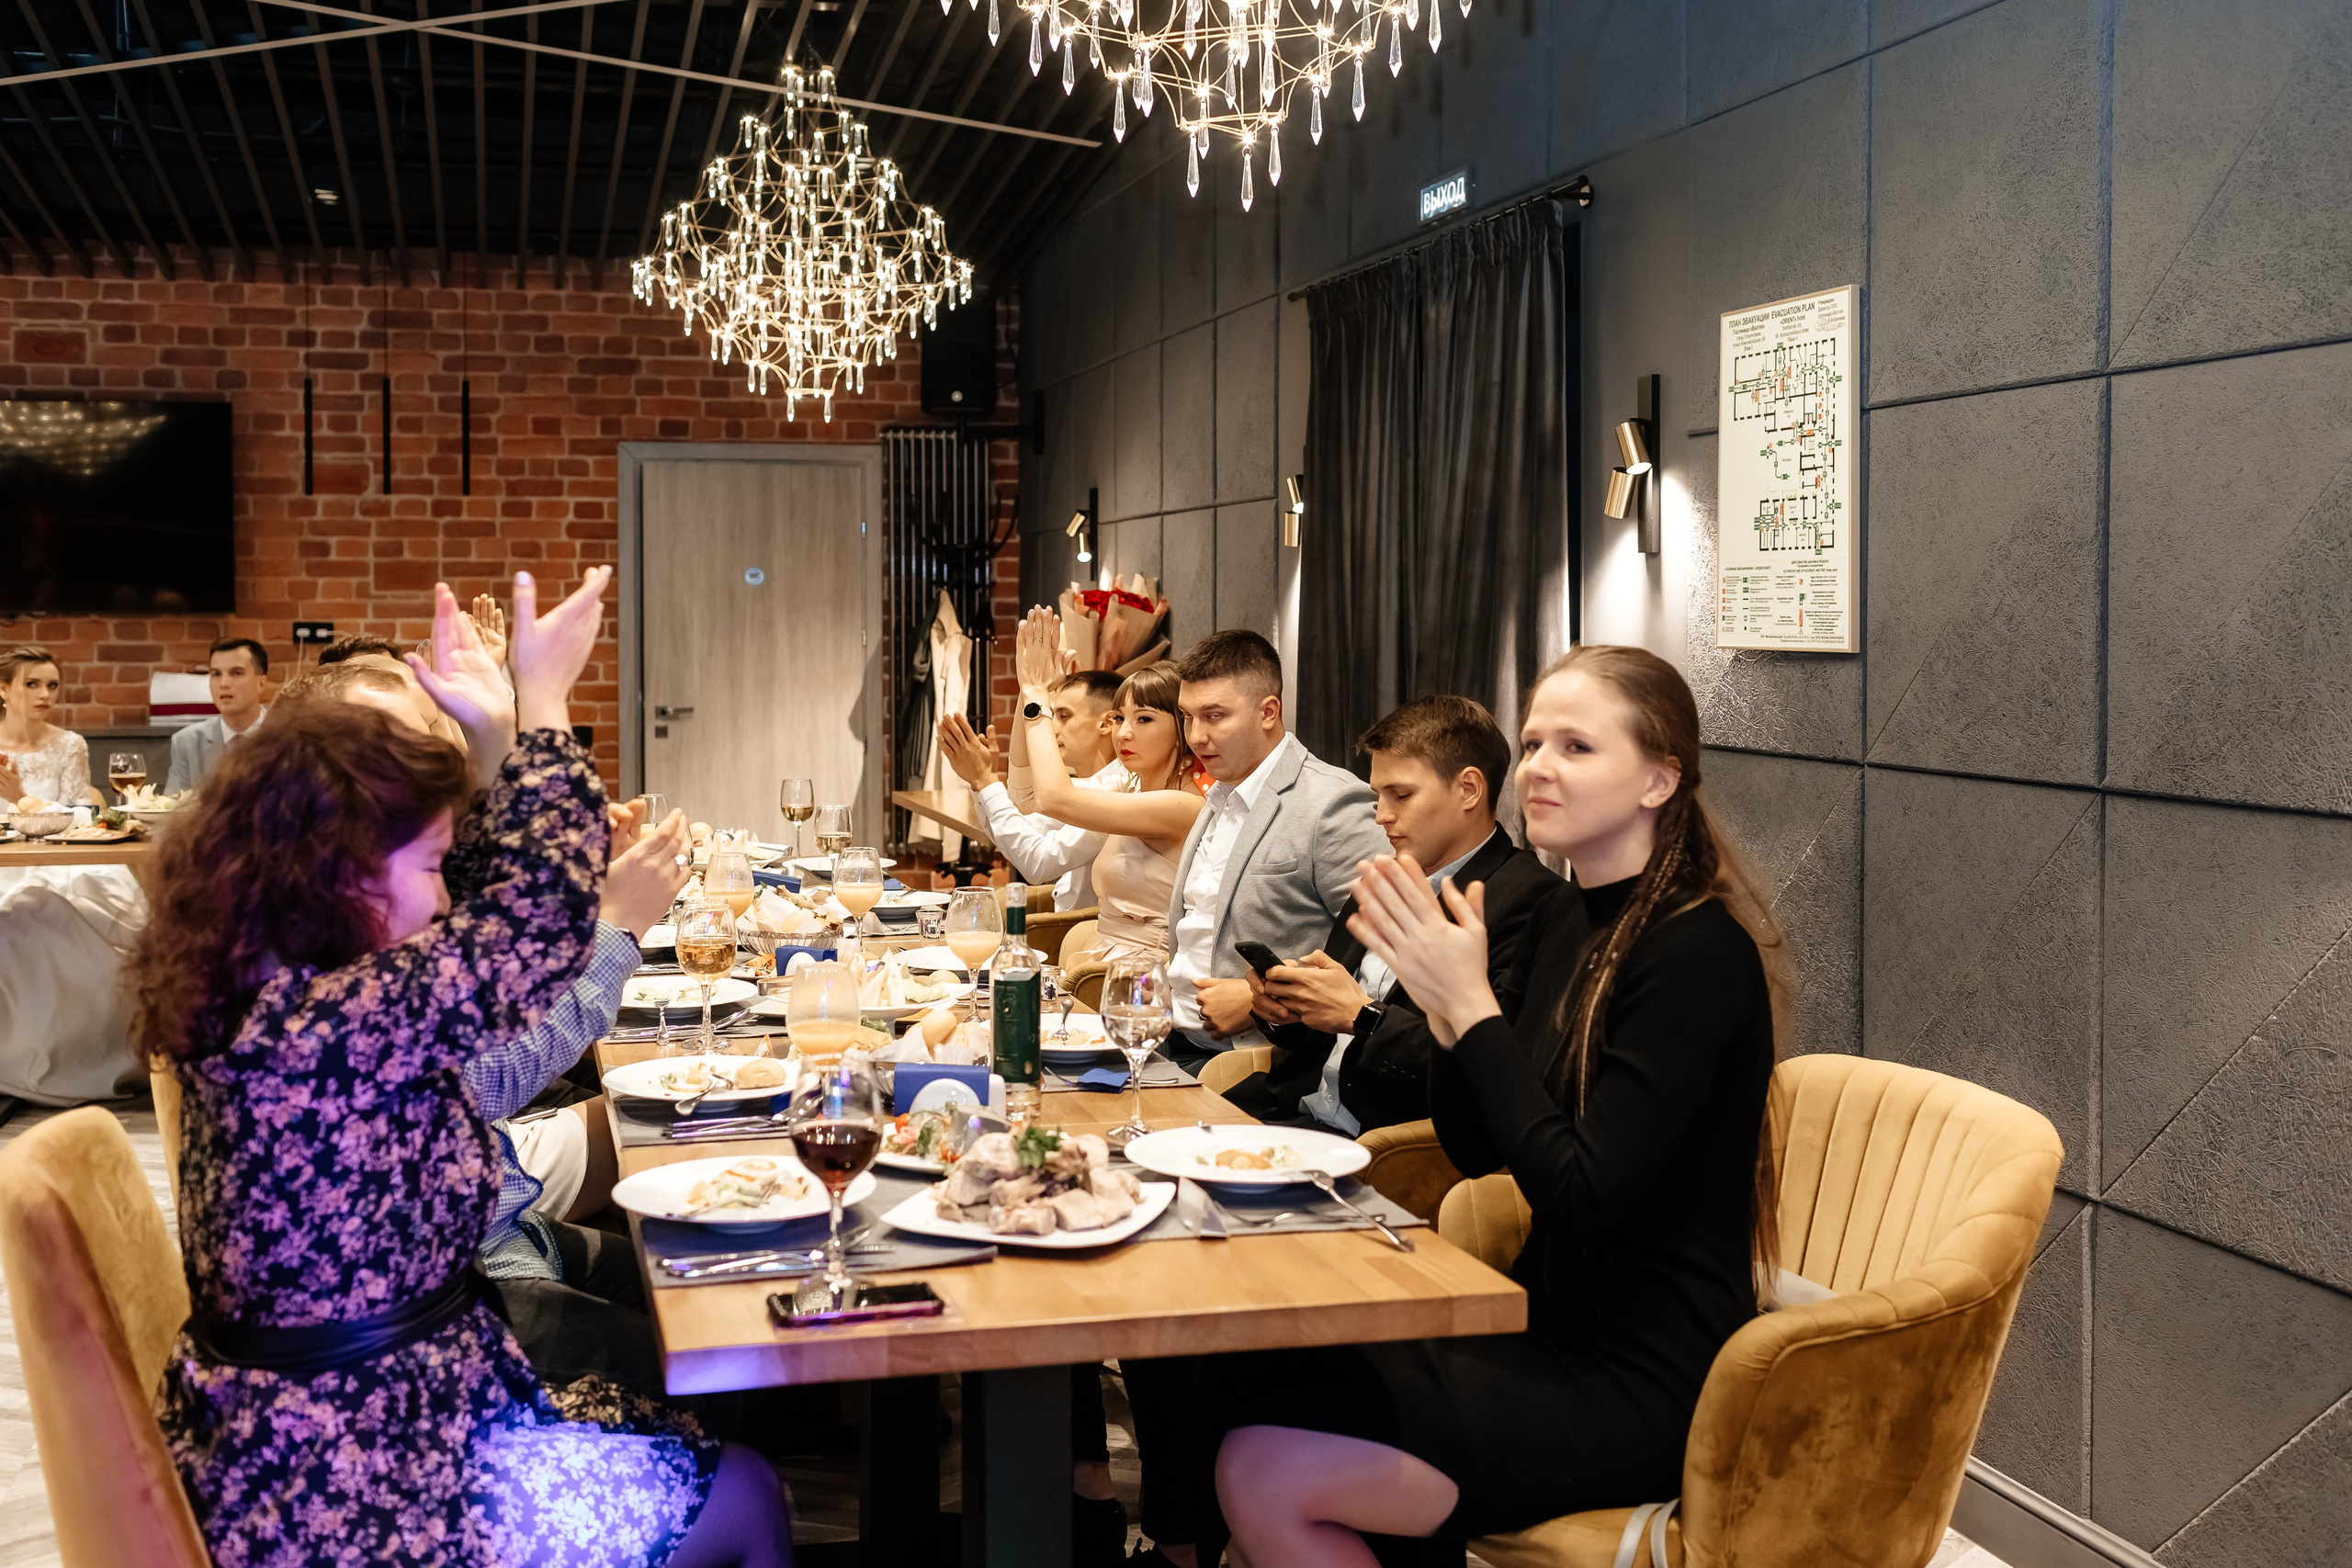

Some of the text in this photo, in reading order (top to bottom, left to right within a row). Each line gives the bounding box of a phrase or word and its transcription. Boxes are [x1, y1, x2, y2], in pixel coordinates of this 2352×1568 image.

[1423, 176, 1465, 214] ВЫХОД
[1728, 302, 1815, 328] ПЛАН ЭВАКУАЦИИ EVACUATION PLAN
